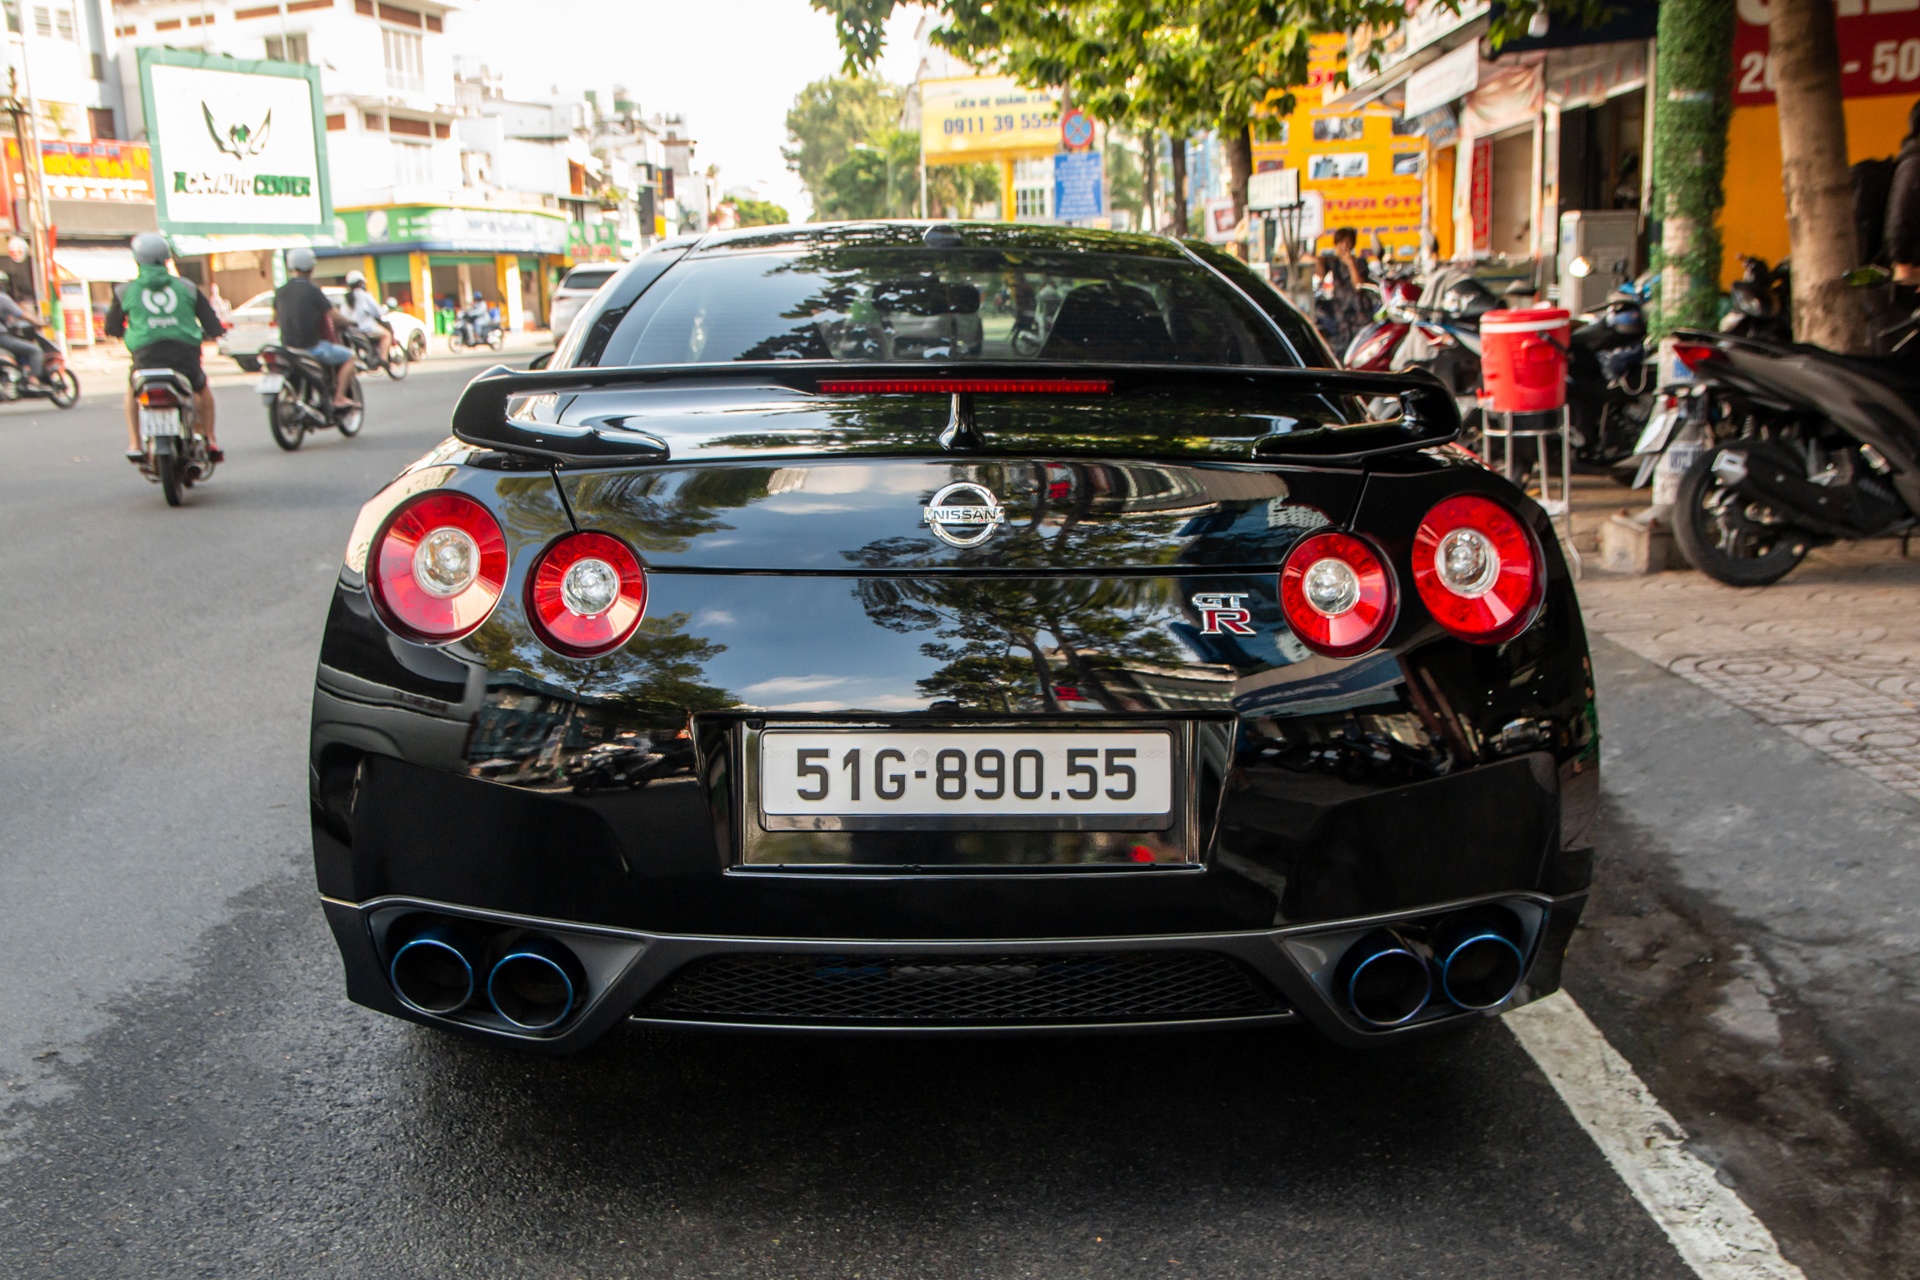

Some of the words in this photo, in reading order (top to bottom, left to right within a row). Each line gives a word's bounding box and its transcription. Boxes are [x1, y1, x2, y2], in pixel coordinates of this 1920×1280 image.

[944, 117, 984, 134] 0911
[993, 114, 1014, 131] 39
[932, 509, 997, 521] NISSAN
[796, 748, 1137, 800] 51G-890.55
